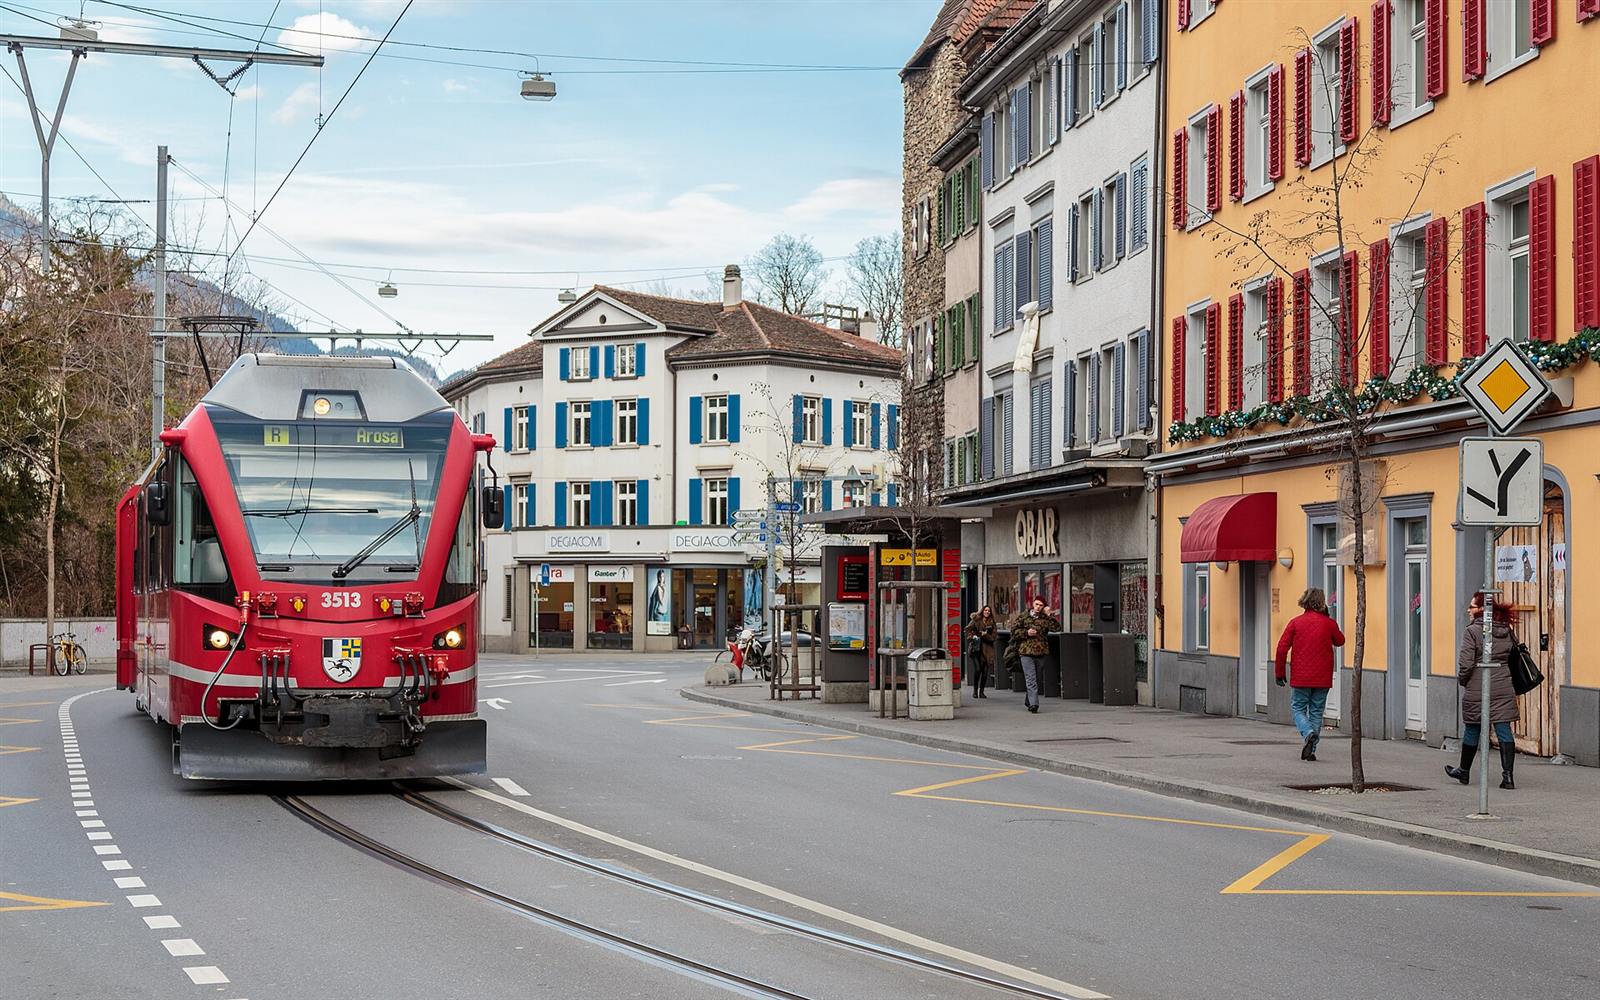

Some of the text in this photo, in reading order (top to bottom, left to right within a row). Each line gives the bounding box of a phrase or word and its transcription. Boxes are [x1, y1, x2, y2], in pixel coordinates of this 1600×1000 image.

[271, 428, 281, 443] R
[356, 427, 399, 444] Arosa
[1015, 508, 1057, 557] QBAR
[550, 535, 603, 548] DEGIACOMI
[594, 570, 617, 578] Ganter
[321, 592, 361, 608] 3513
